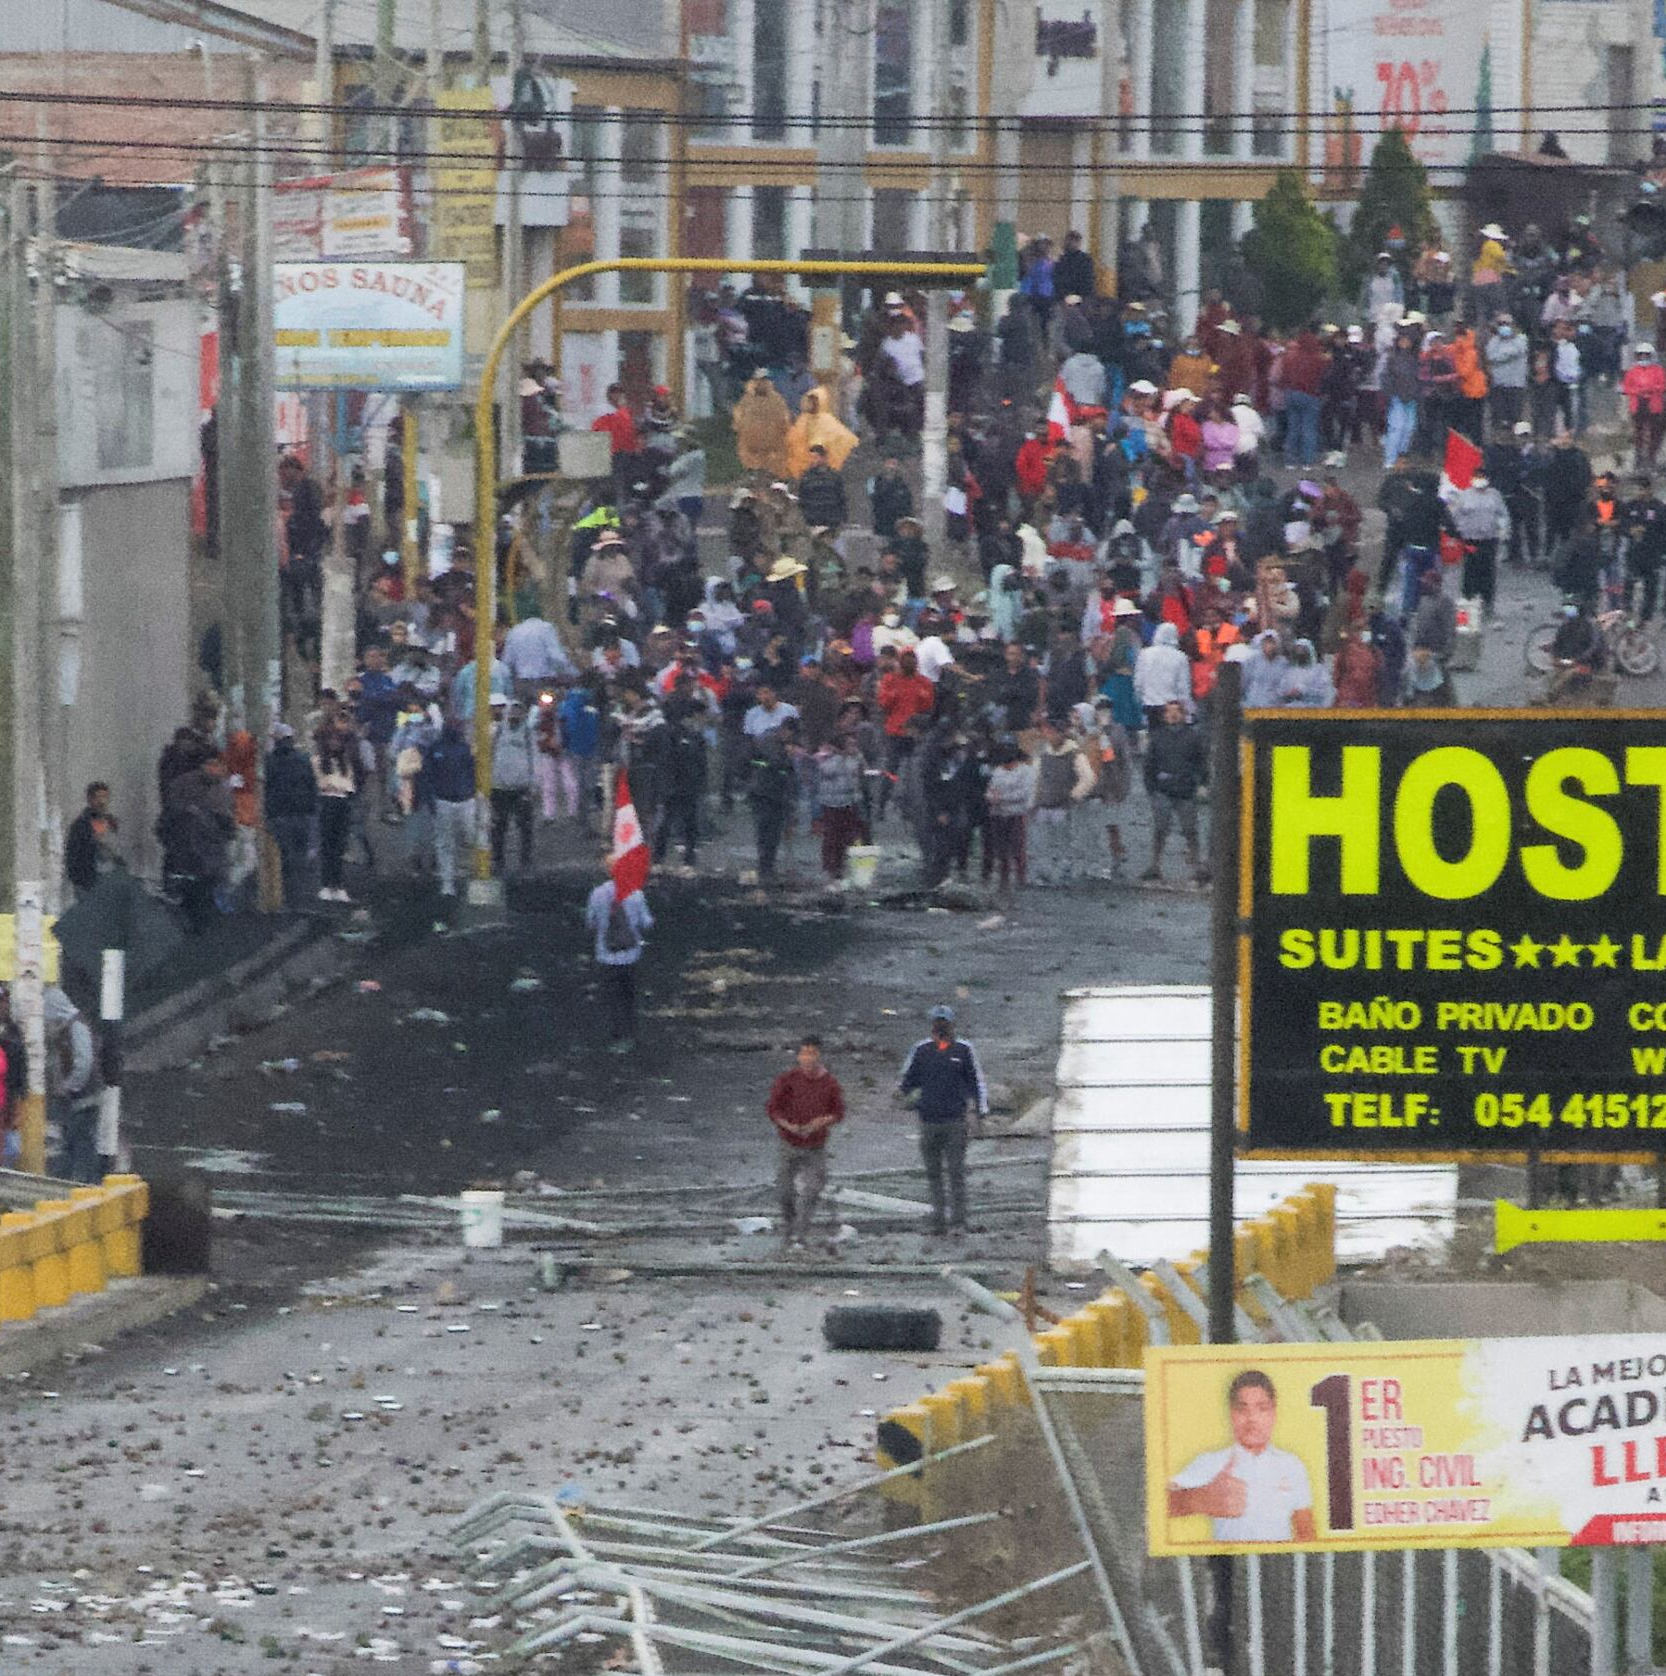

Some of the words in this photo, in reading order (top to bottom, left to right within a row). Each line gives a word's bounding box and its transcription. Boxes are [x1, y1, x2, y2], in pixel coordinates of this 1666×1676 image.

[1279, 929, 1504, 969] SUITES
[1318, 996, 1422, 1031] BAÑO
[1437, 1002, 1594, 1032] PRIVADO
[1320, 1046, 1439, 1076] CABLE
[1456, 1046, 1507, 1075] TV
[1324, 1092, 1441, 1128] TELF:
[1474, 1092, 1552, 1128] 054
[1548, 1366, 1583, 1390] LA
[1361, 1378, 1402, 1421] ER
[1310, 1374, 1354, 1531] 1
[1362, 1427, 1423, 1449] PUESTO
[1362, 1456, 1412, 1490] ING.
[1420, 1454, 1482, 1488] CIVIL
[1646, 1486, 1662, 1503] A
